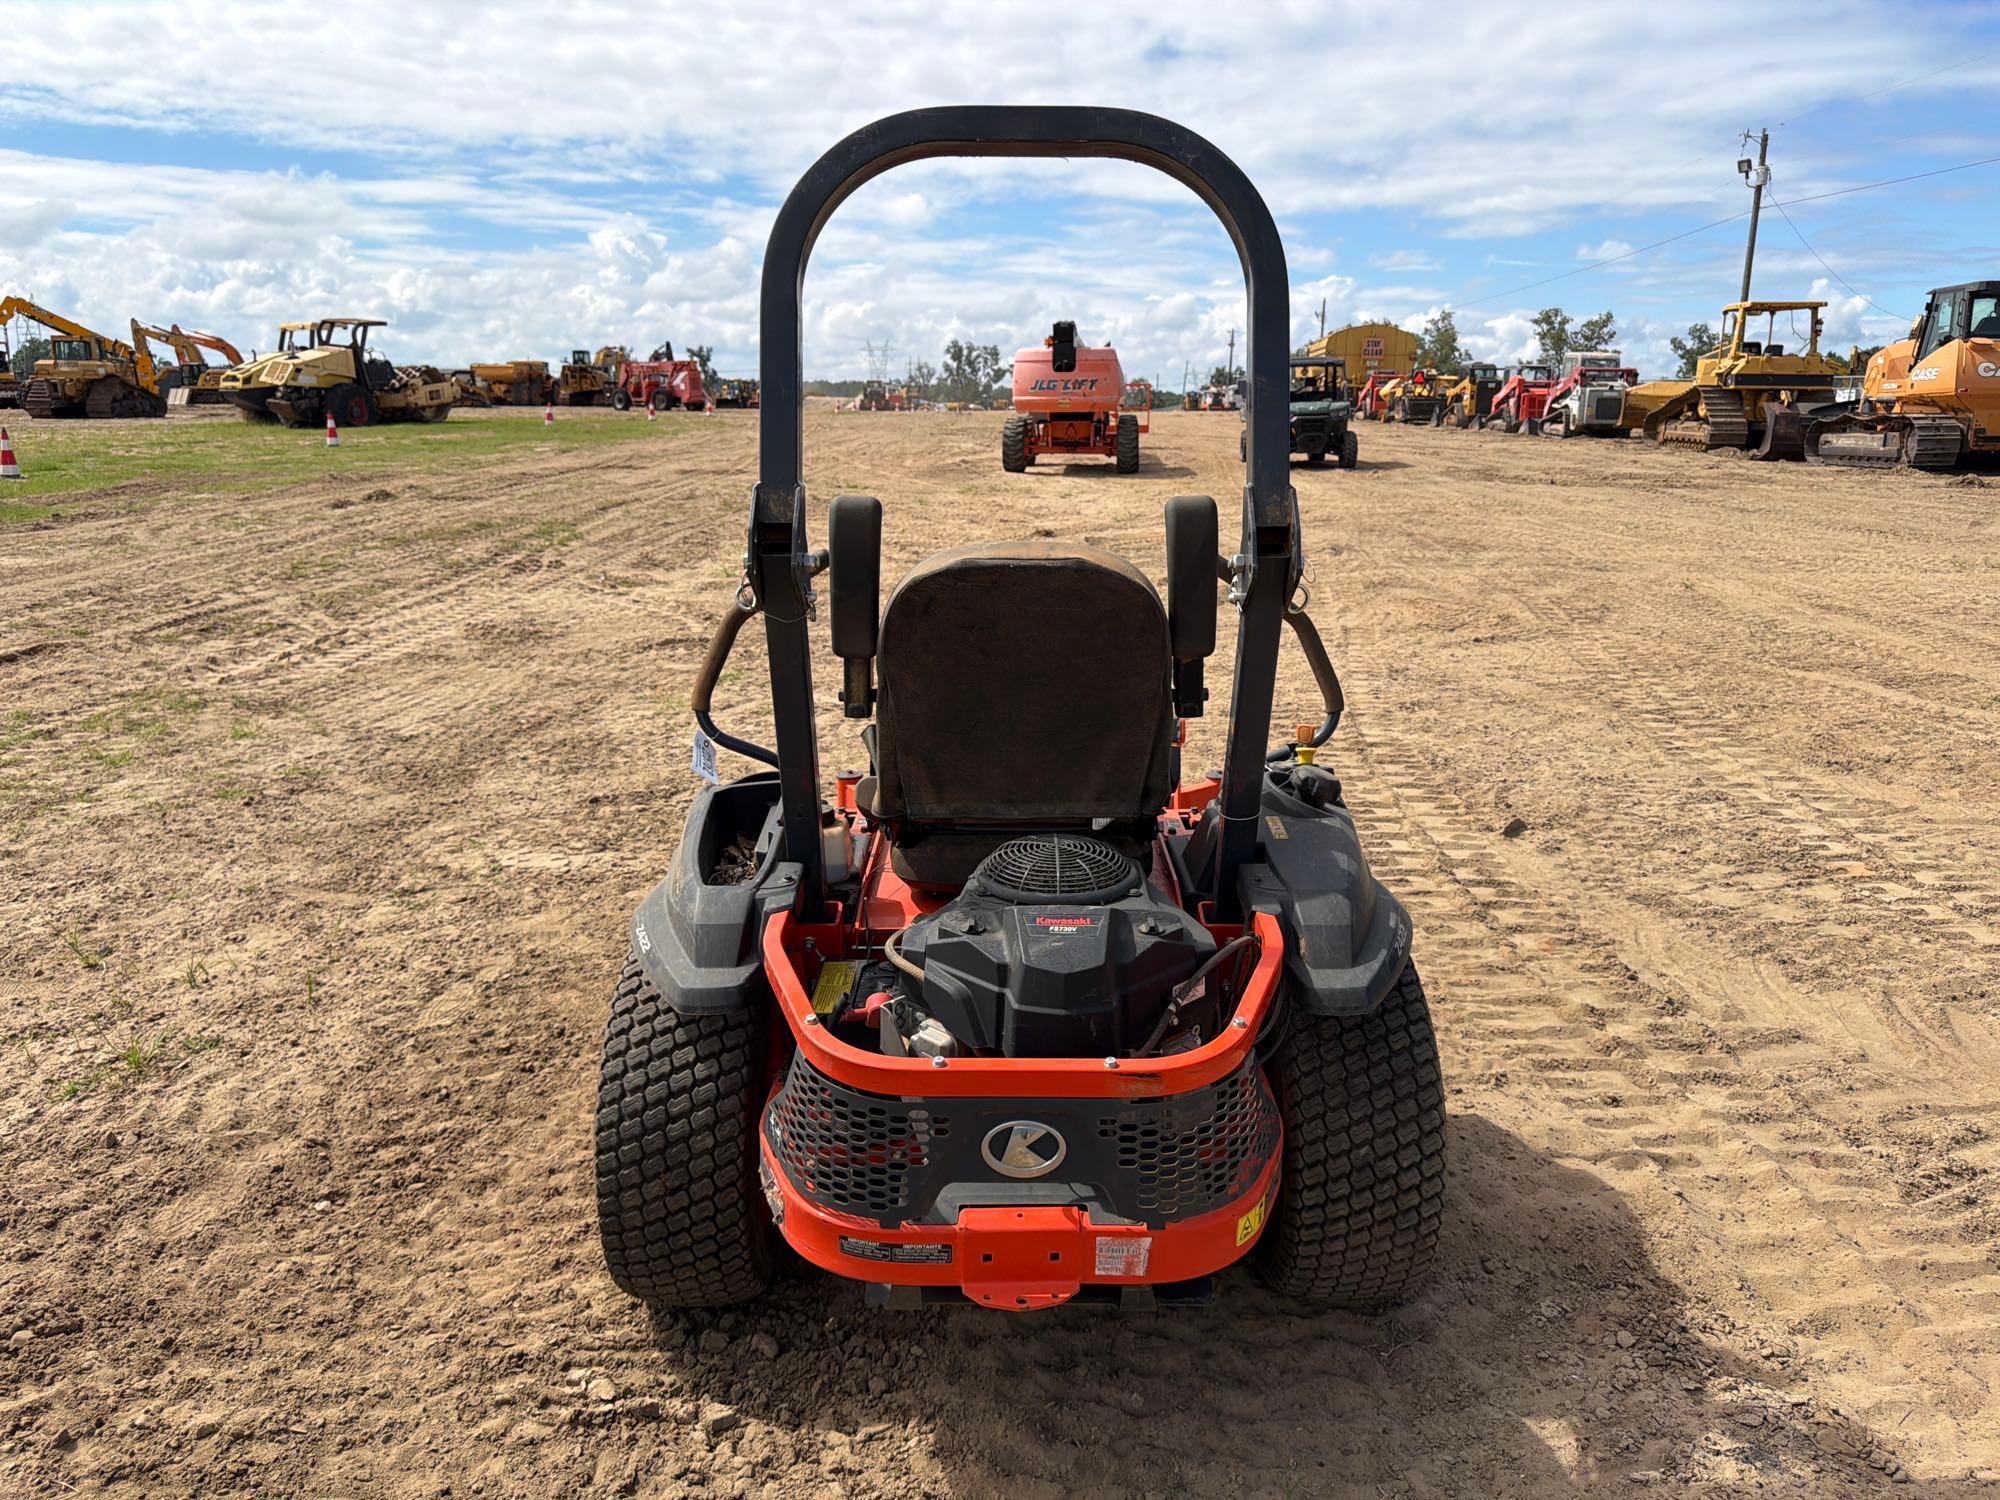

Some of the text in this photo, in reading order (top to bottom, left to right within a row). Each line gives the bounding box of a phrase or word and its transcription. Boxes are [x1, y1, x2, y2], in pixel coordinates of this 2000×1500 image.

[1363, 348, 1383, 356] CLEAR
[1911, 367, 1940, 381] CASE
[1030, 379, 1098, 391] JLG LIFT
[1036, 916, 1092, 926] Kawasaki
[1048, 925, 1078, 933] FS730V
[847, 1237, 880, 1247] IMPORTANT
